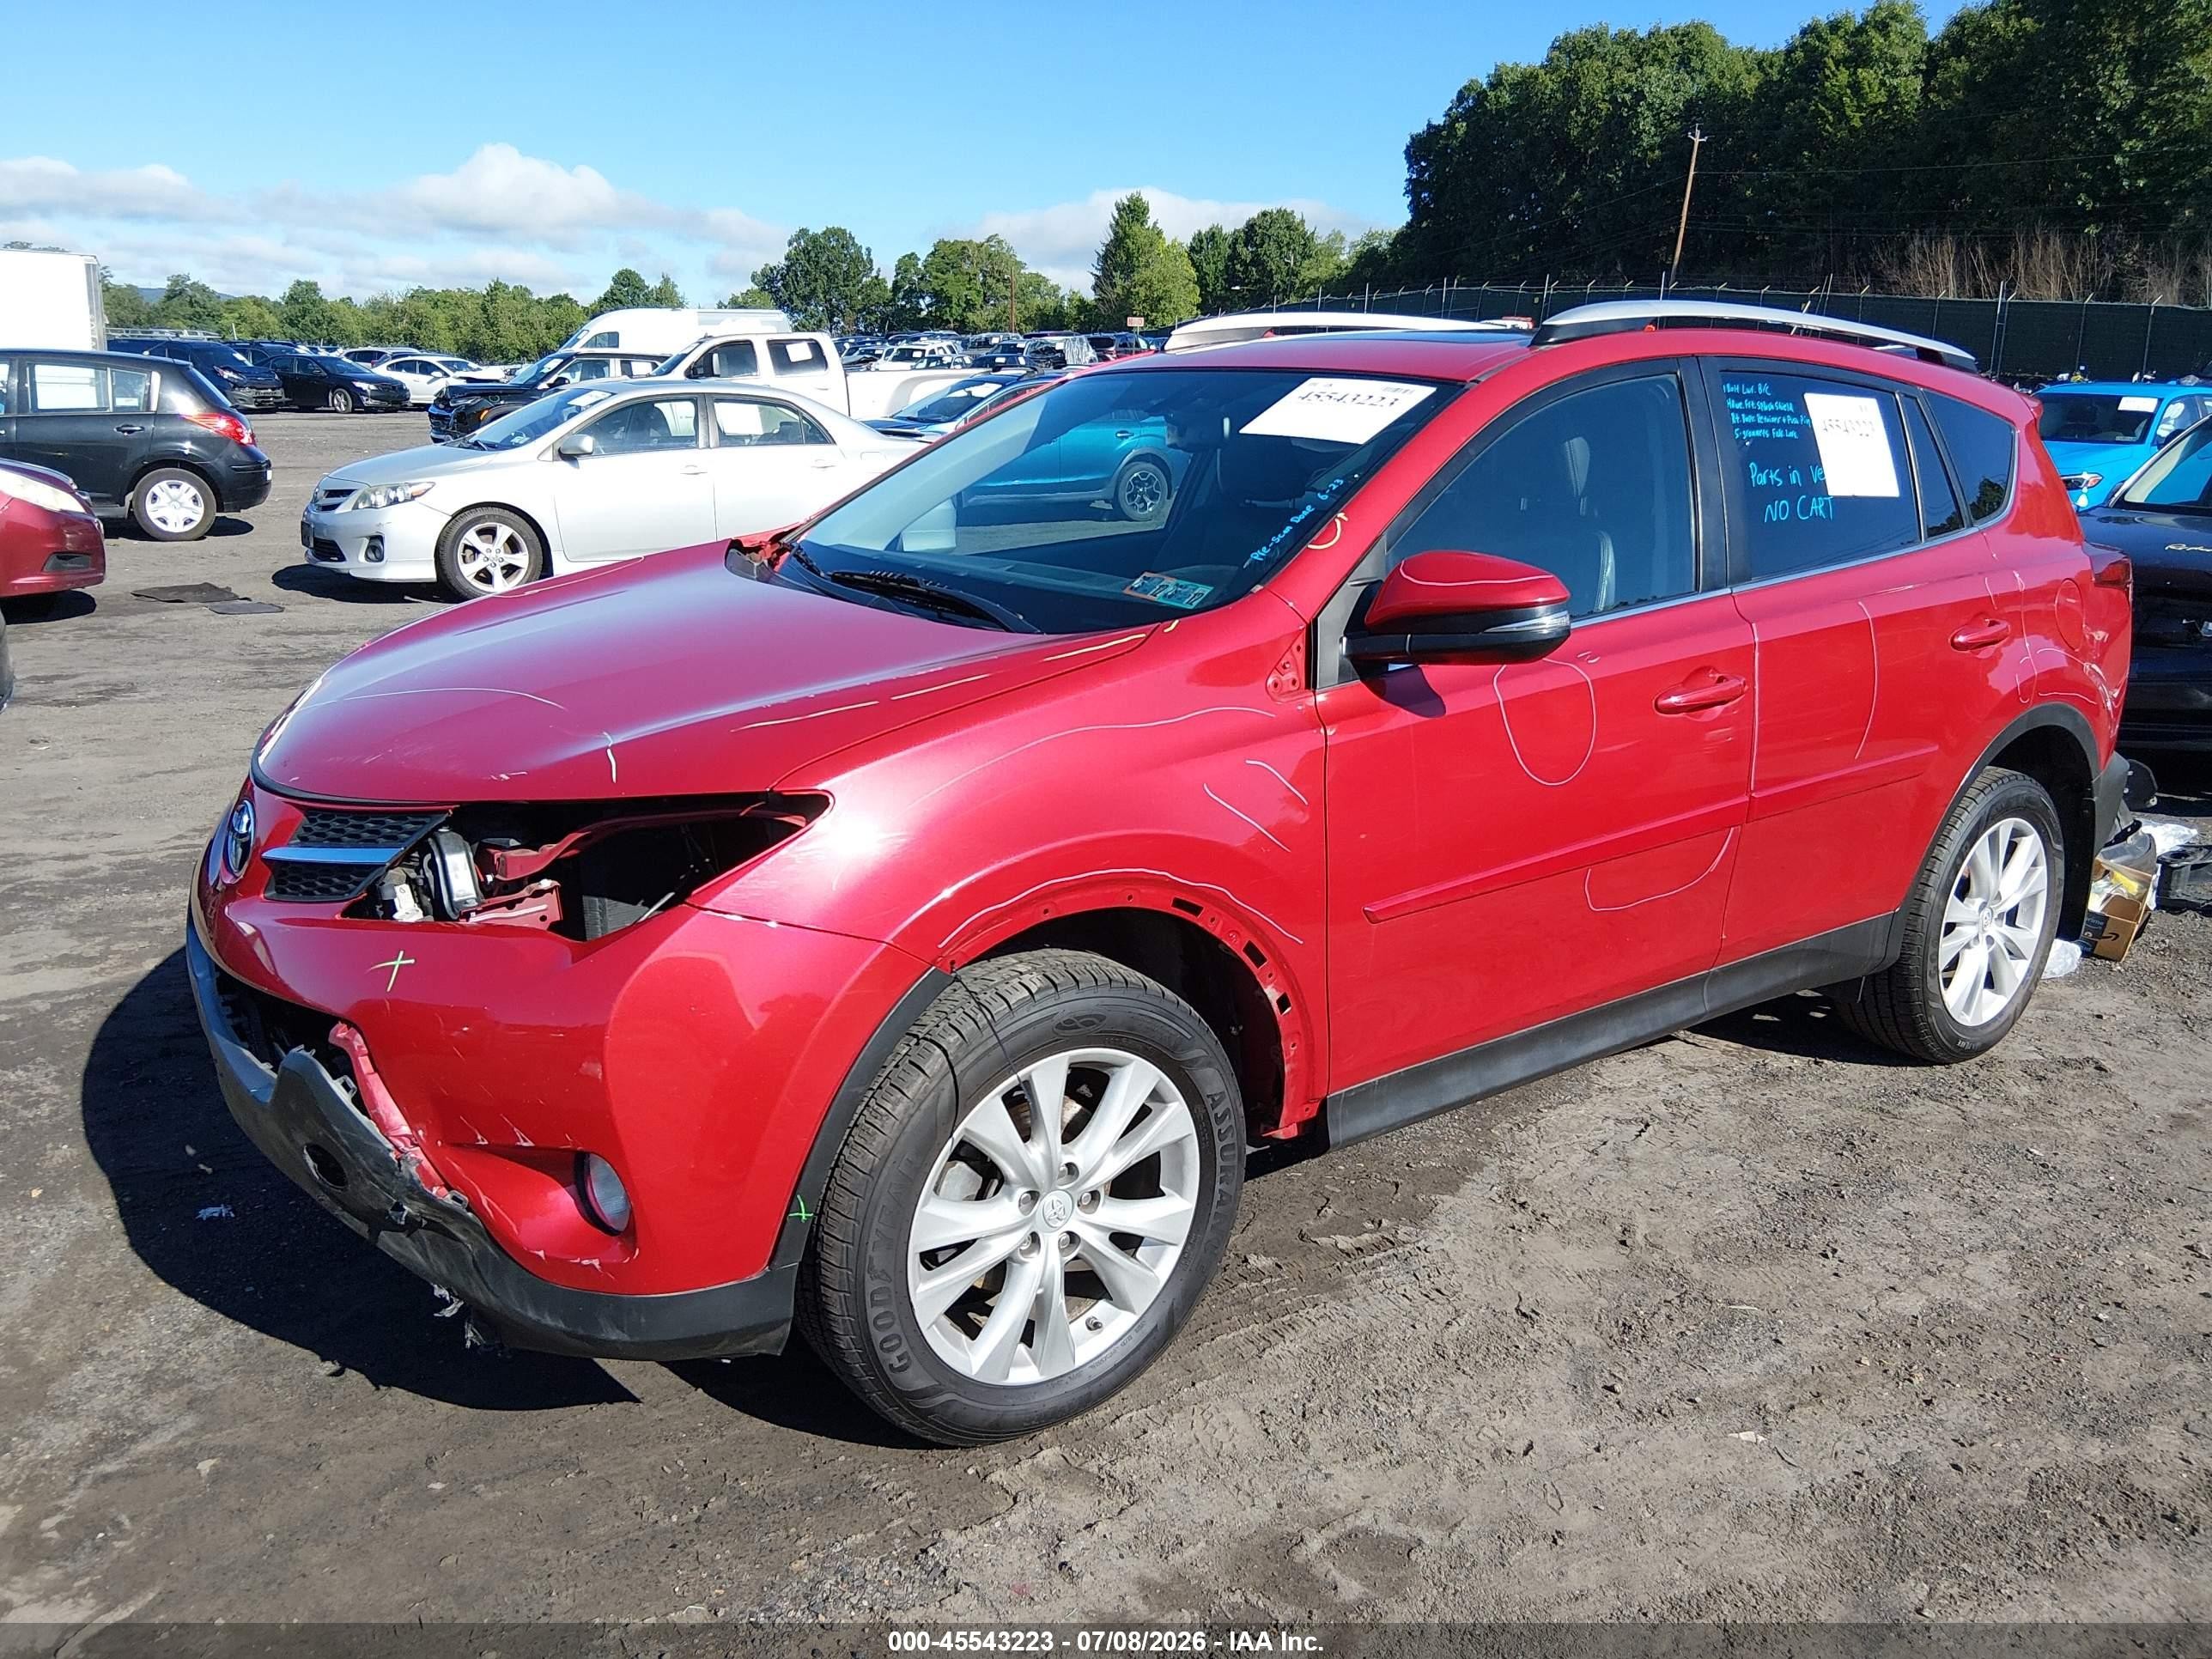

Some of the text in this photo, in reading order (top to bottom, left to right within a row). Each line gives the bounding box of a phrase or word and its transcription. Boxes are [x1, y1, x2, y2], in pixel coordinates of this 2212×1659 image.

[1298, 391, 1399, 407] 45543223
[1749, 461, 1784, 488] Parts
[1788, 465, 1802, 487] in
[1290, 504, 1316, 524] Done
[1317, 478, 1344, 501] 6-23
[1764, 495, 1834, 523] NO CART
